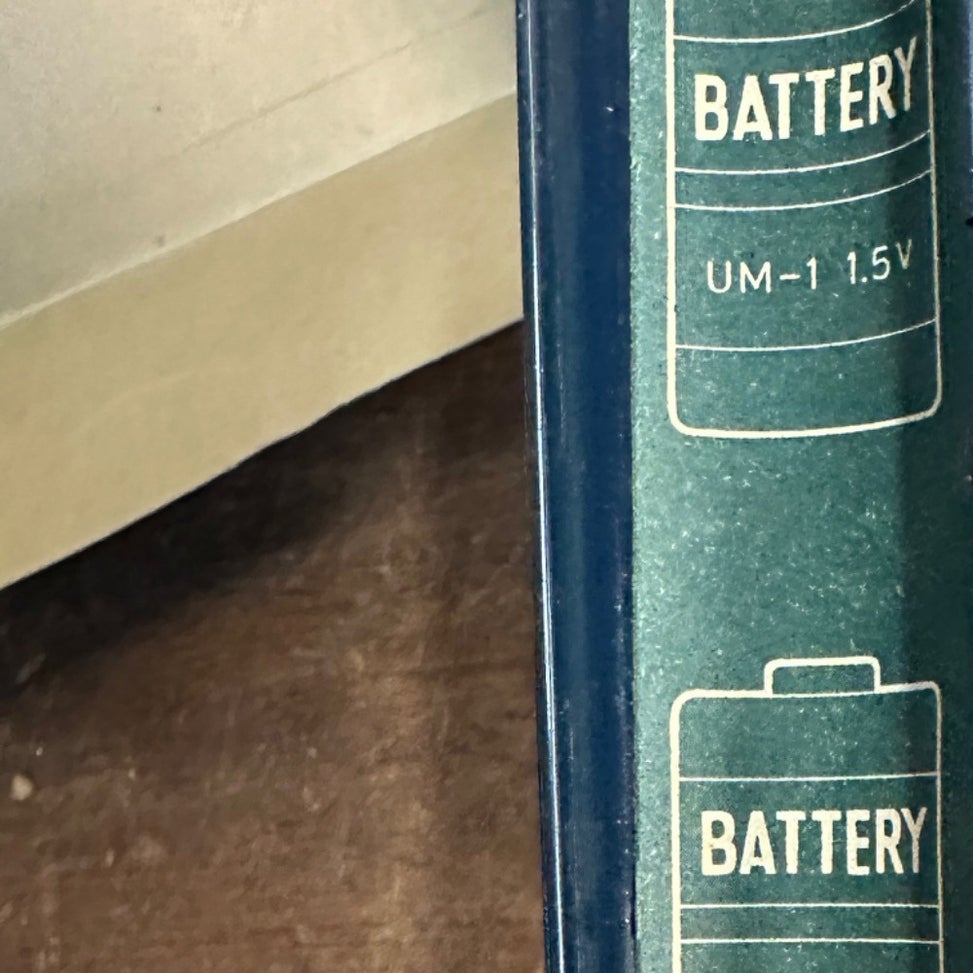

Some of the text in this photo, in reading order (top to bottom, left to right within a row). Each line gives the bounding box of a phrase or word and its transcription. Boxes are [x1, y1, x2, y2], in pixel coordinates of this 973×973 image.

[694, 36, 917, 142] BATTERY
[706, 239, 913, 294] UM-1 1.5V
[700, 807, 927, 876] BATTERY
